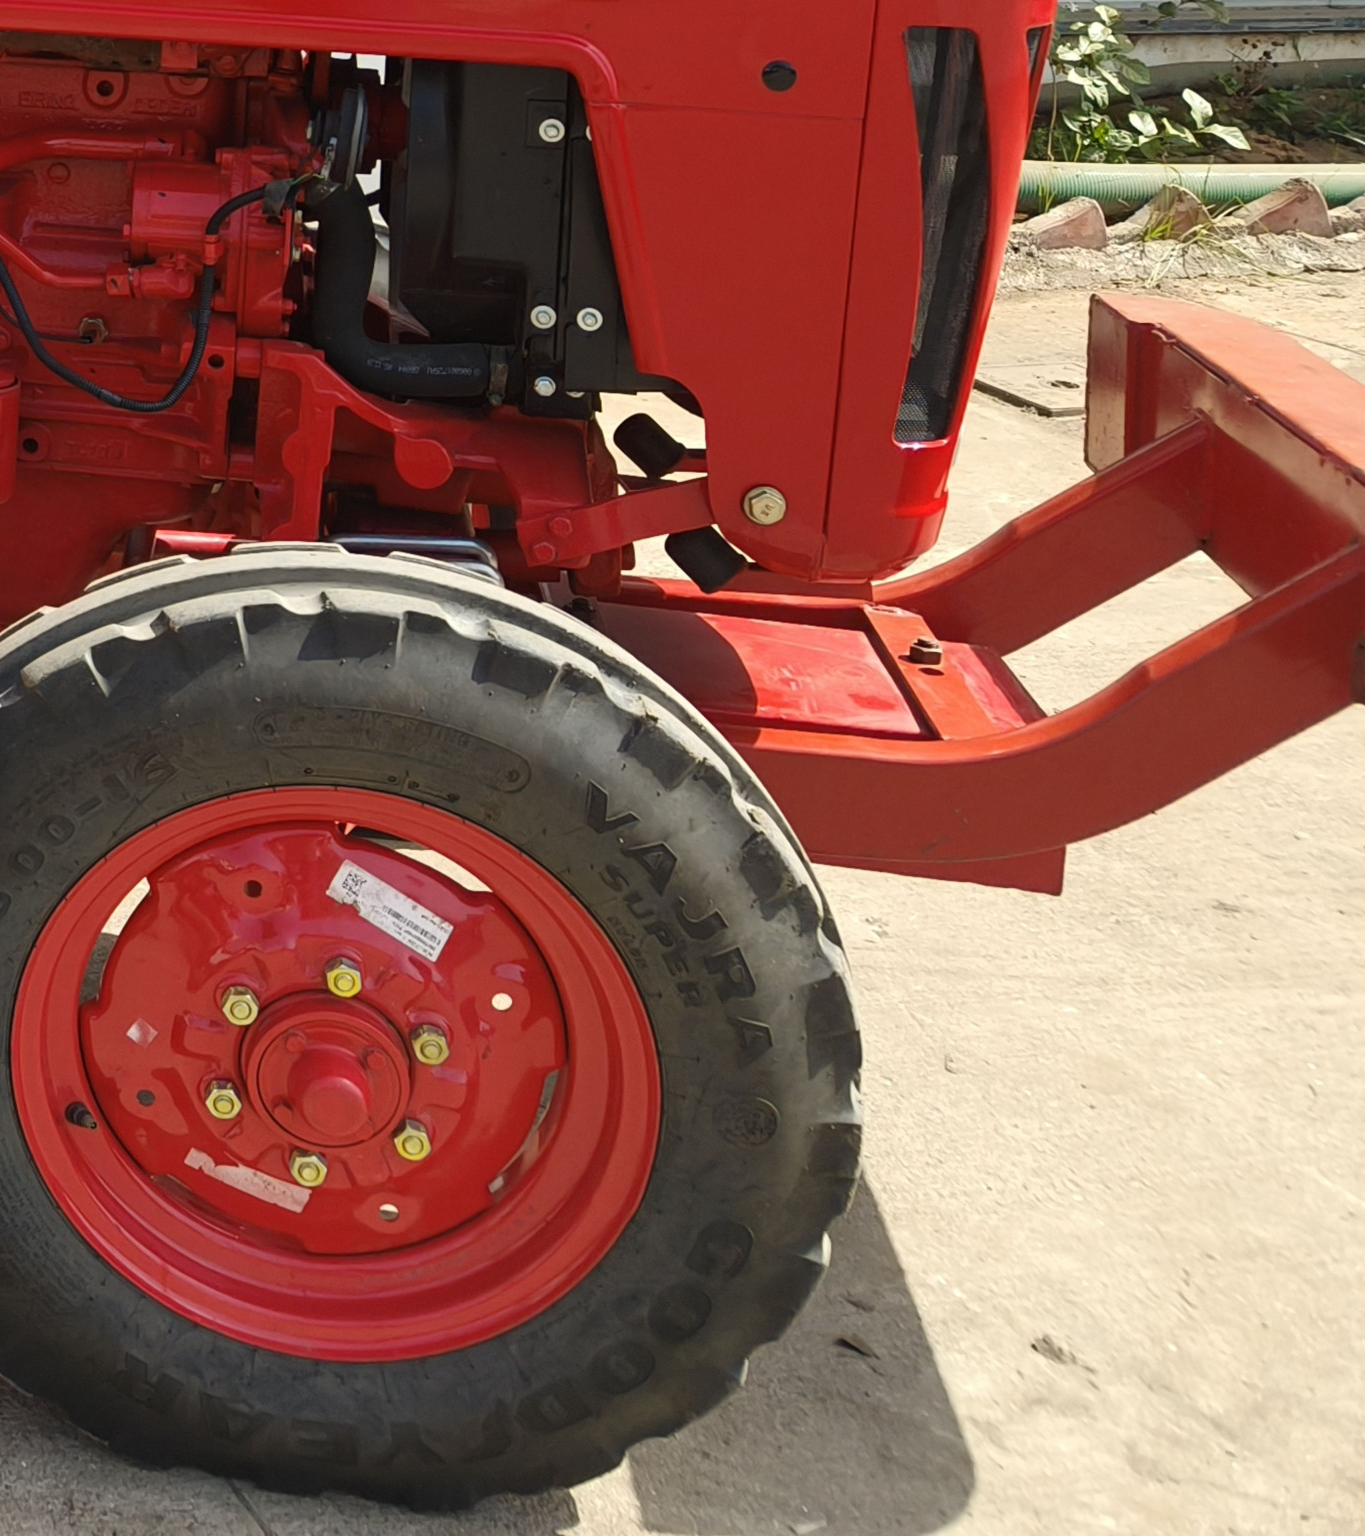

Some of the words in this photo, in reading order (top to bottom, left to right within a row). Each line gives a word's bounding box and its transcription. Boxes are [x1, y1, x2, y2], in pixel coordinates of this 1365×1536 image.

[585, 778, 774, 1070] VAJRA
[598, 862, 709, 1009] SUPER
[112, 1217, 756, 1467] GOODYEAR
